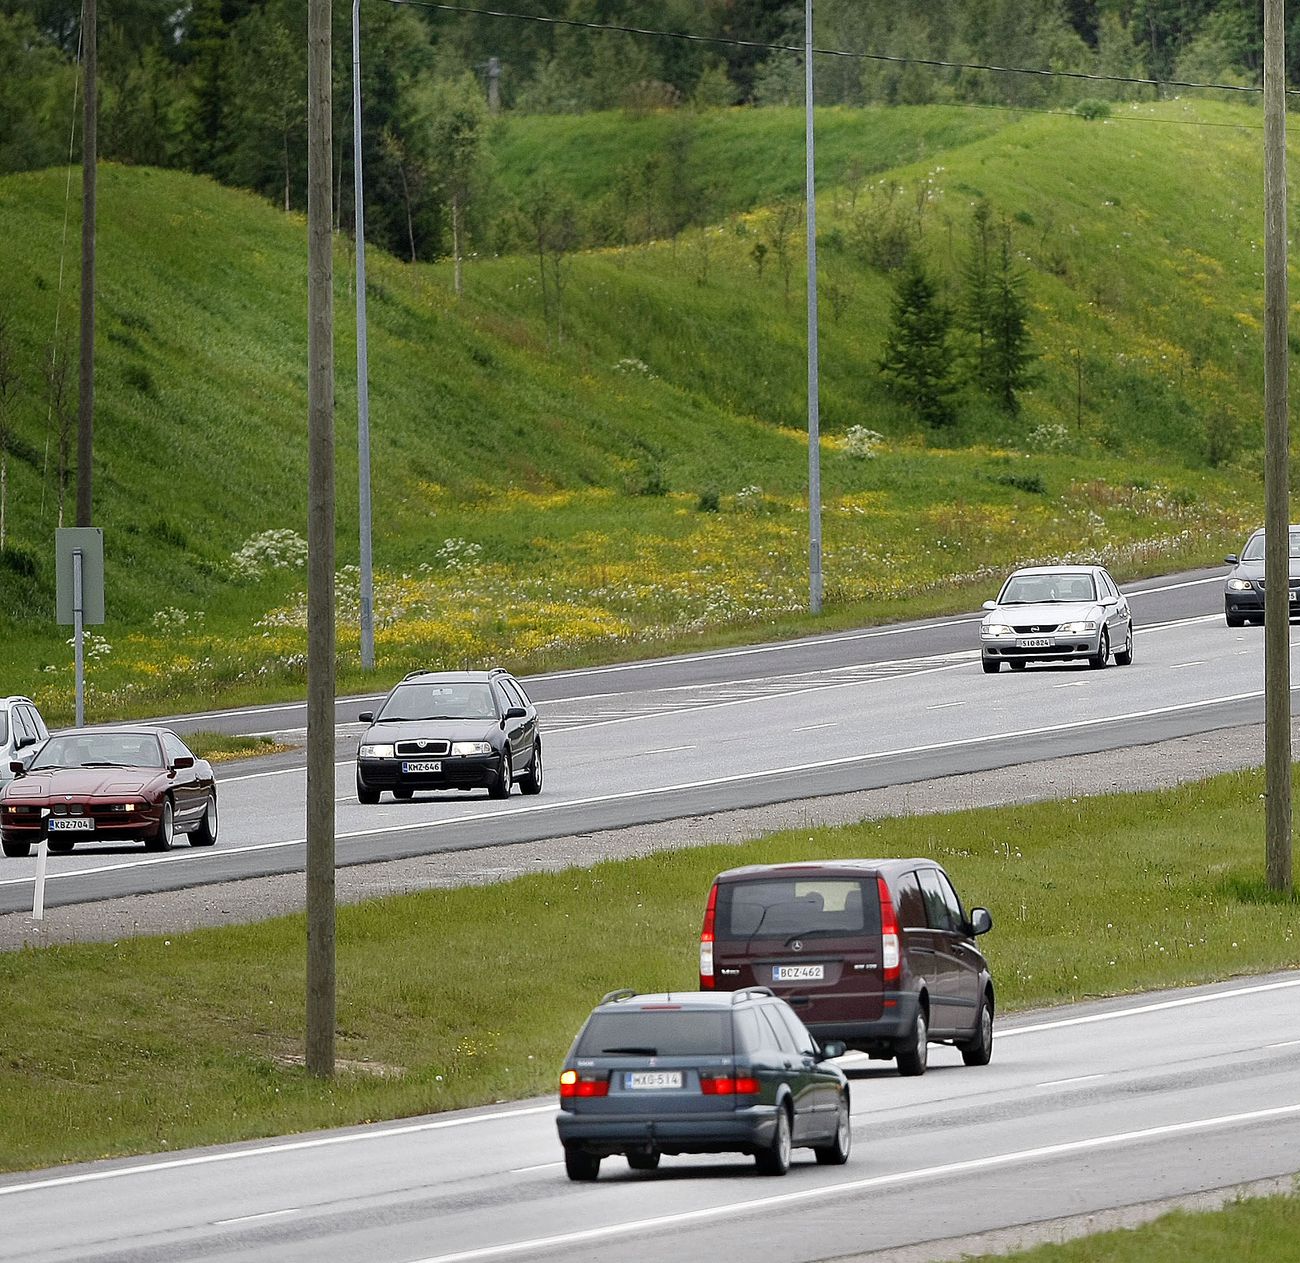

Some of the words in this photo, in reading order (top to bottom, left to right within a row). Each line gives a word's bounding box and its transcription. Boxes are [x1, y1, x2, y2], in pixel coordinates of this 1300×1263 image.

[408, 763, 440, 771] KMZ-646
[55, 820, 88, 829] KBZ-704
[781, 967, 821, 978] BCZ-462
